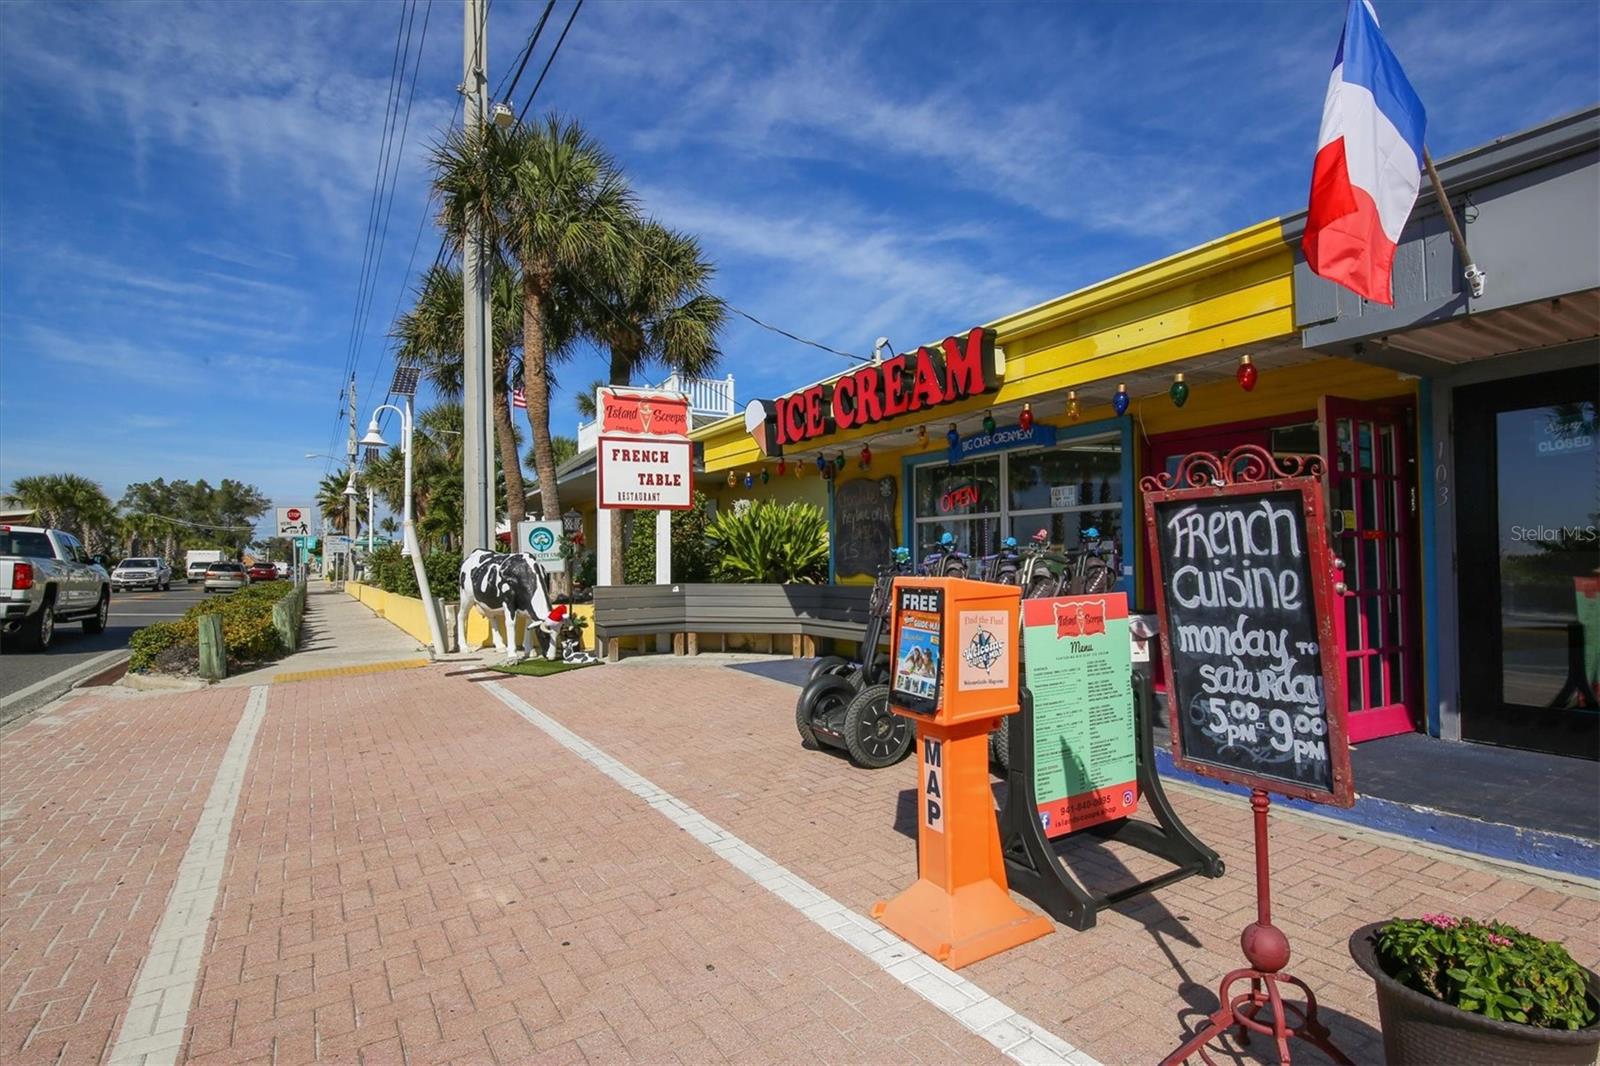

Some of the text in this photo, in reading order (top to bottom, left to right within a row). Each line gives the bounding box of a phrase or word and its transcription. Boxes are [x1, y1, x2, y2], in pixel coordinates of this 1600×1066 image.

[776, 327, 986, 445] ICE CREAM
[606, 404, 686, 424] Island Scoops
[962, 440, 973, 452] BIG
[1538, 435, 1592, 452] CLOSED
[612, 448, 670, 463] FRENCH
[638, 473, 681, 487] TABLE
[1436, 441, 1449, 506] 103
[618, 491, 661, 501] RESTAURANT
[941, 486, 979, 512] OPEN
[902, 593, 938, 612] FREE
[1070, 641, 1093, 653] Menu
[925, 738, 941, 826] MAP
